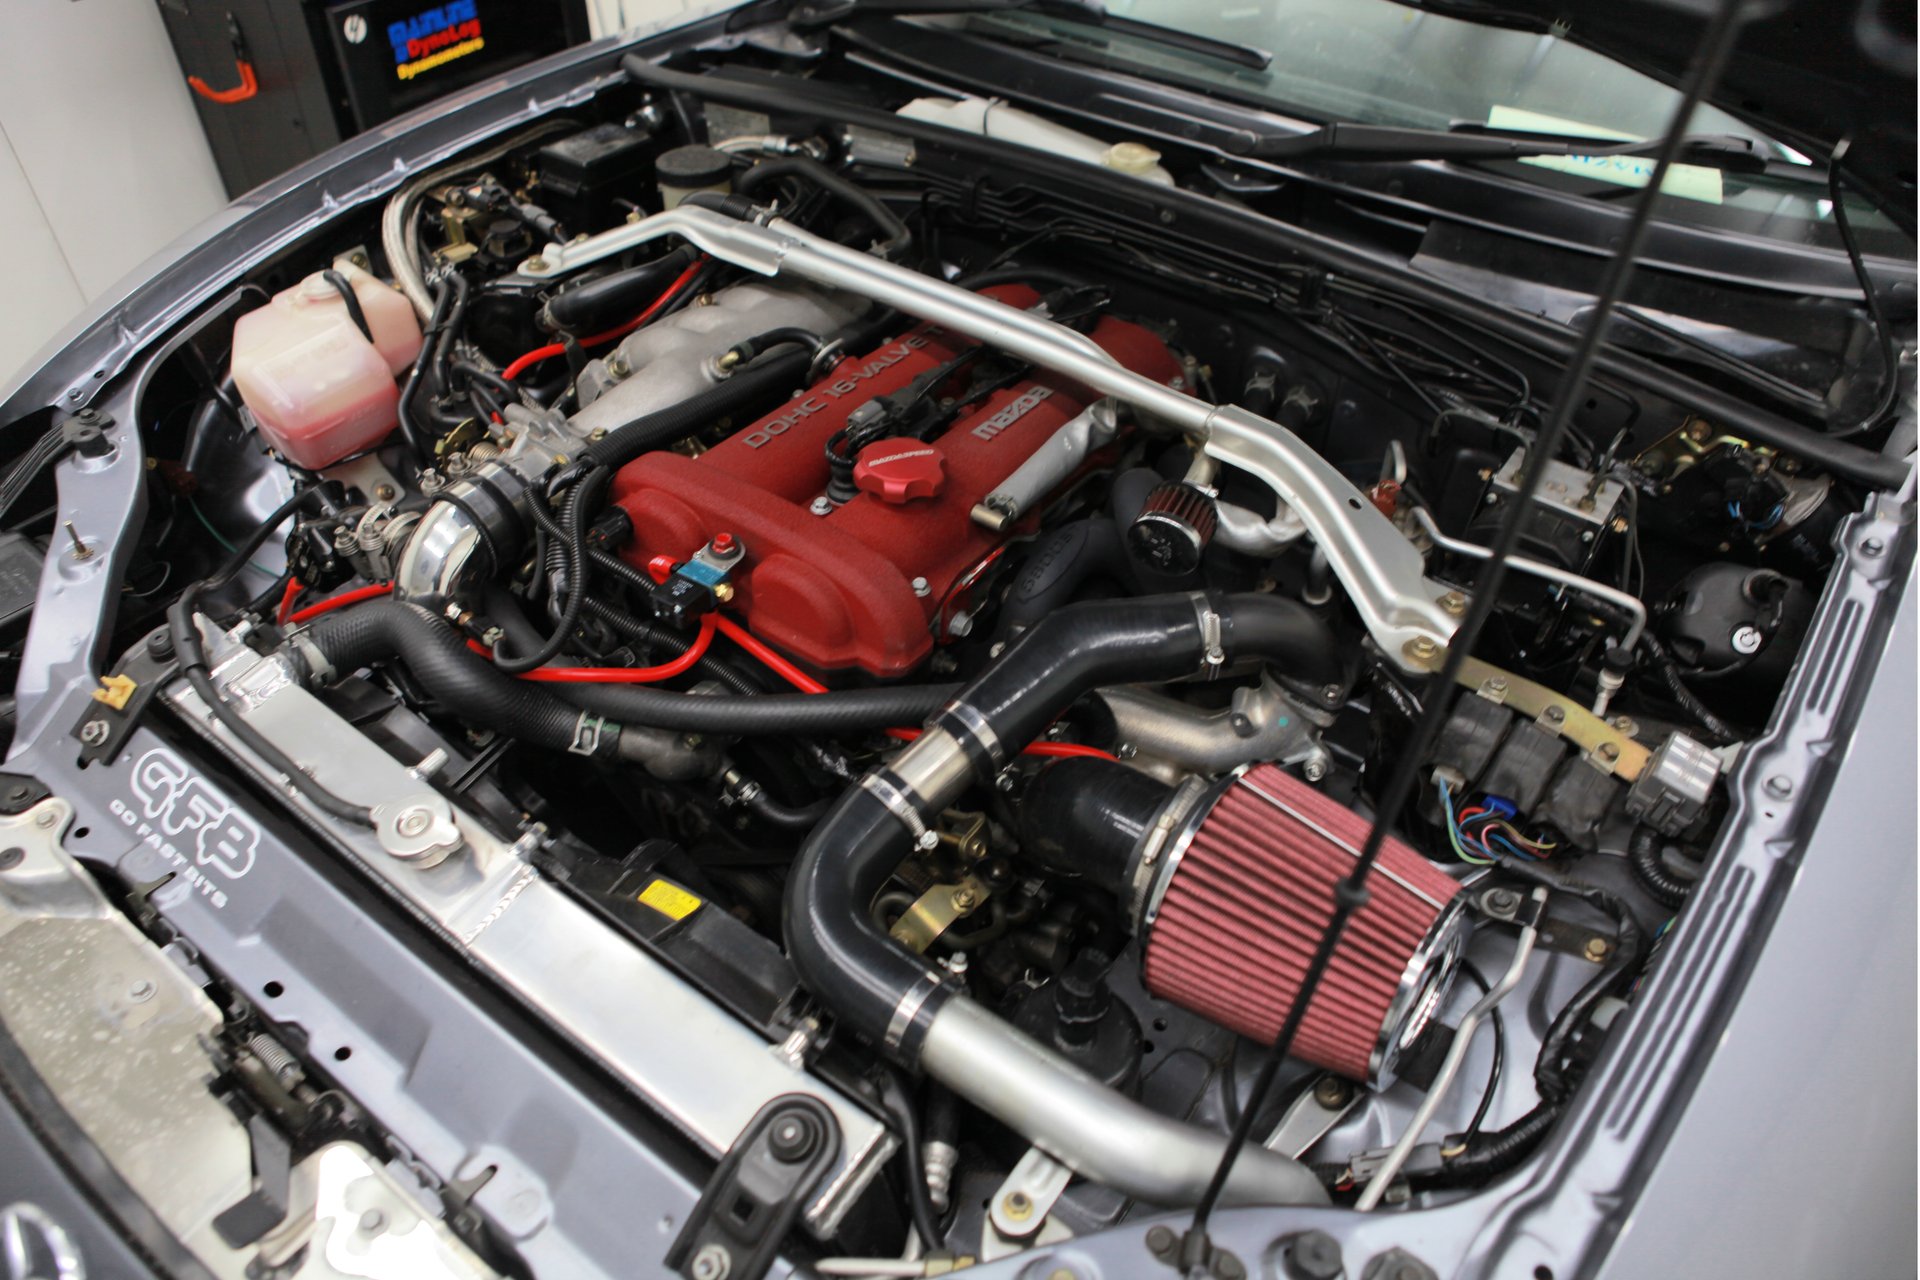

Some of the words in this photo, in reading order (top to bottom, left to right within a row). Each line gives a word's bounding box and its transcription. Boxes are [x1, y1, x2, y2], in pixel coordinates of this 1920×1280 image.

[743, 398, 828, 449] DOHC
[823, 336, 929, 401] 16-VALVE
[868, 448, 935, 467] MAZDASPEED
[109, 799, 138, 826] GO
[136, 823, 188, 867] FAST
[183, 865, 229, 909] BITS
[131, 748, 261, 879] GFB
